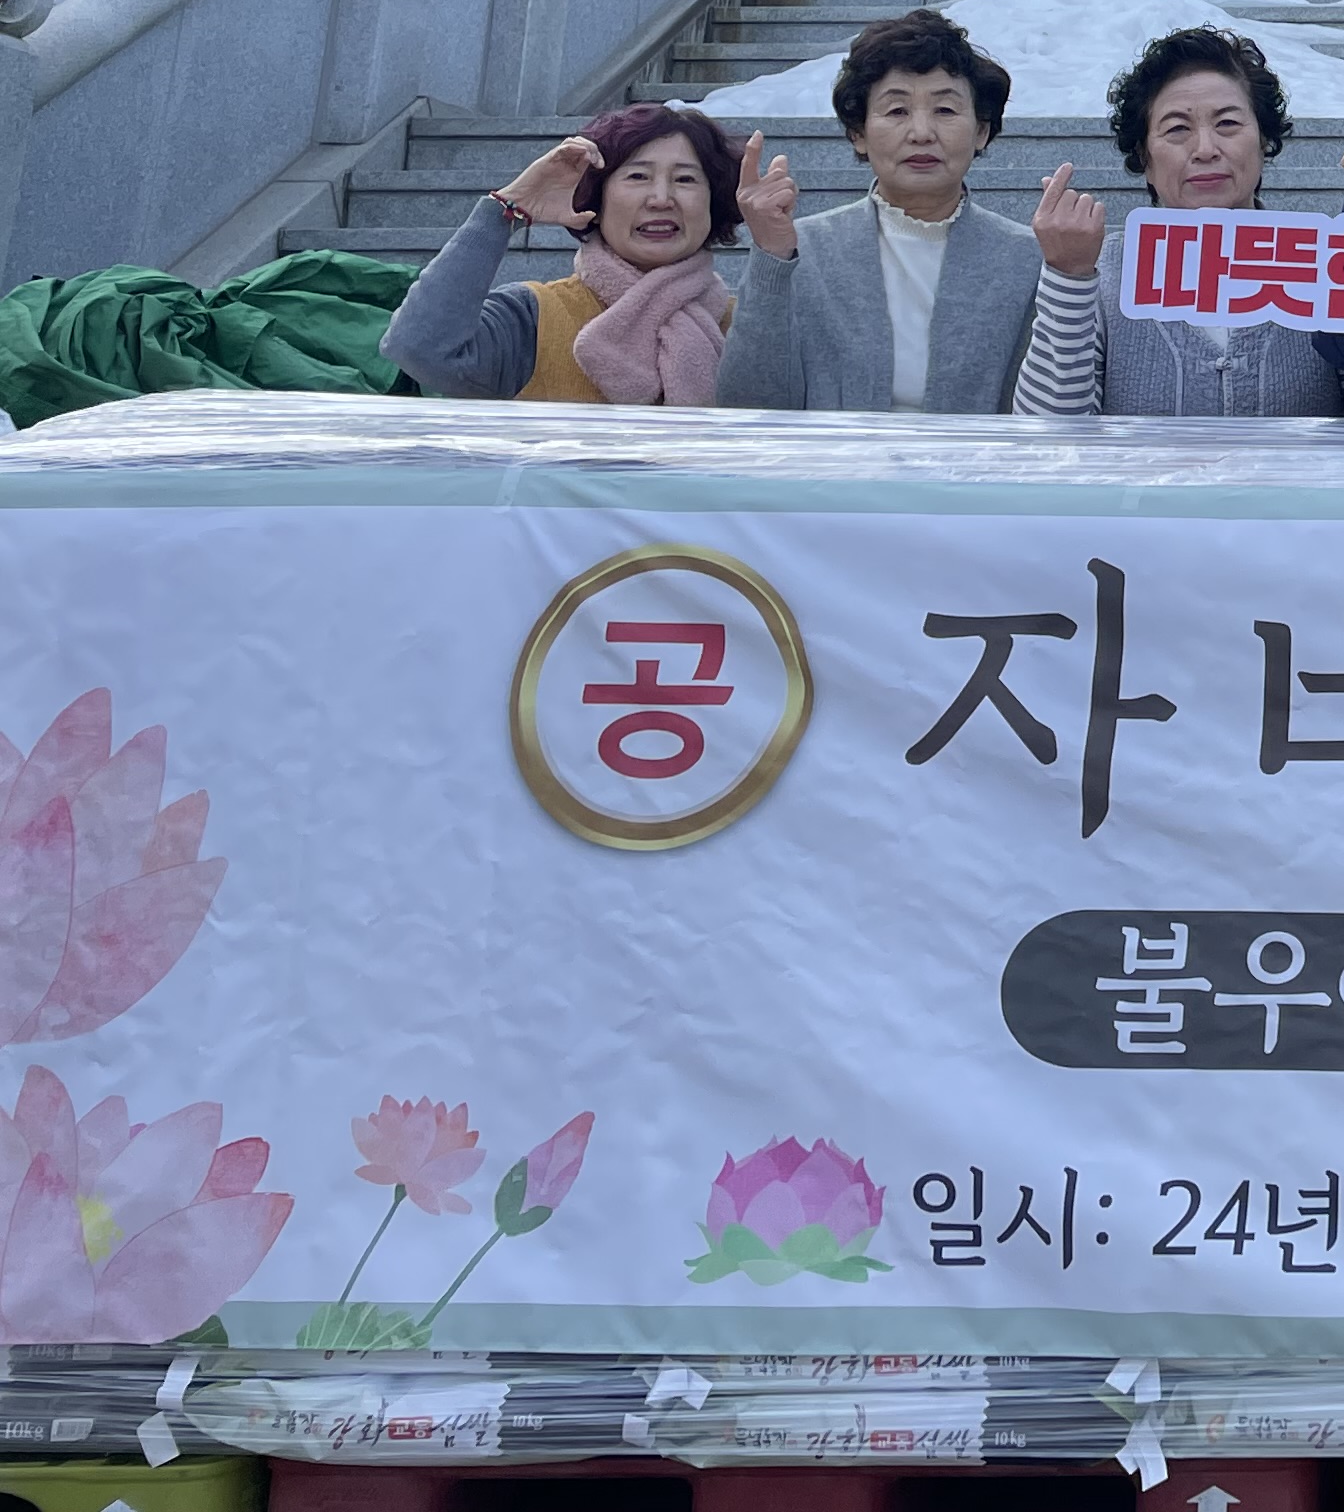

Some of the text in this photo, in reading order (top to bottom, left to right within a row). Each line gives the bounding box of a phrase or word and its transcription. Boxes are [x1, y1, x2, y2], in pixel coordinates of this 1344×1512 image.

[581, 620, 735, 780] 공
[913, 1166, 1113, 1270] 일시:
[1152, 1170, 1340, 1273] 24년
[4, 1421, 44, 1440] 10kg
[512, 1415, 544, 1430] 10kg
